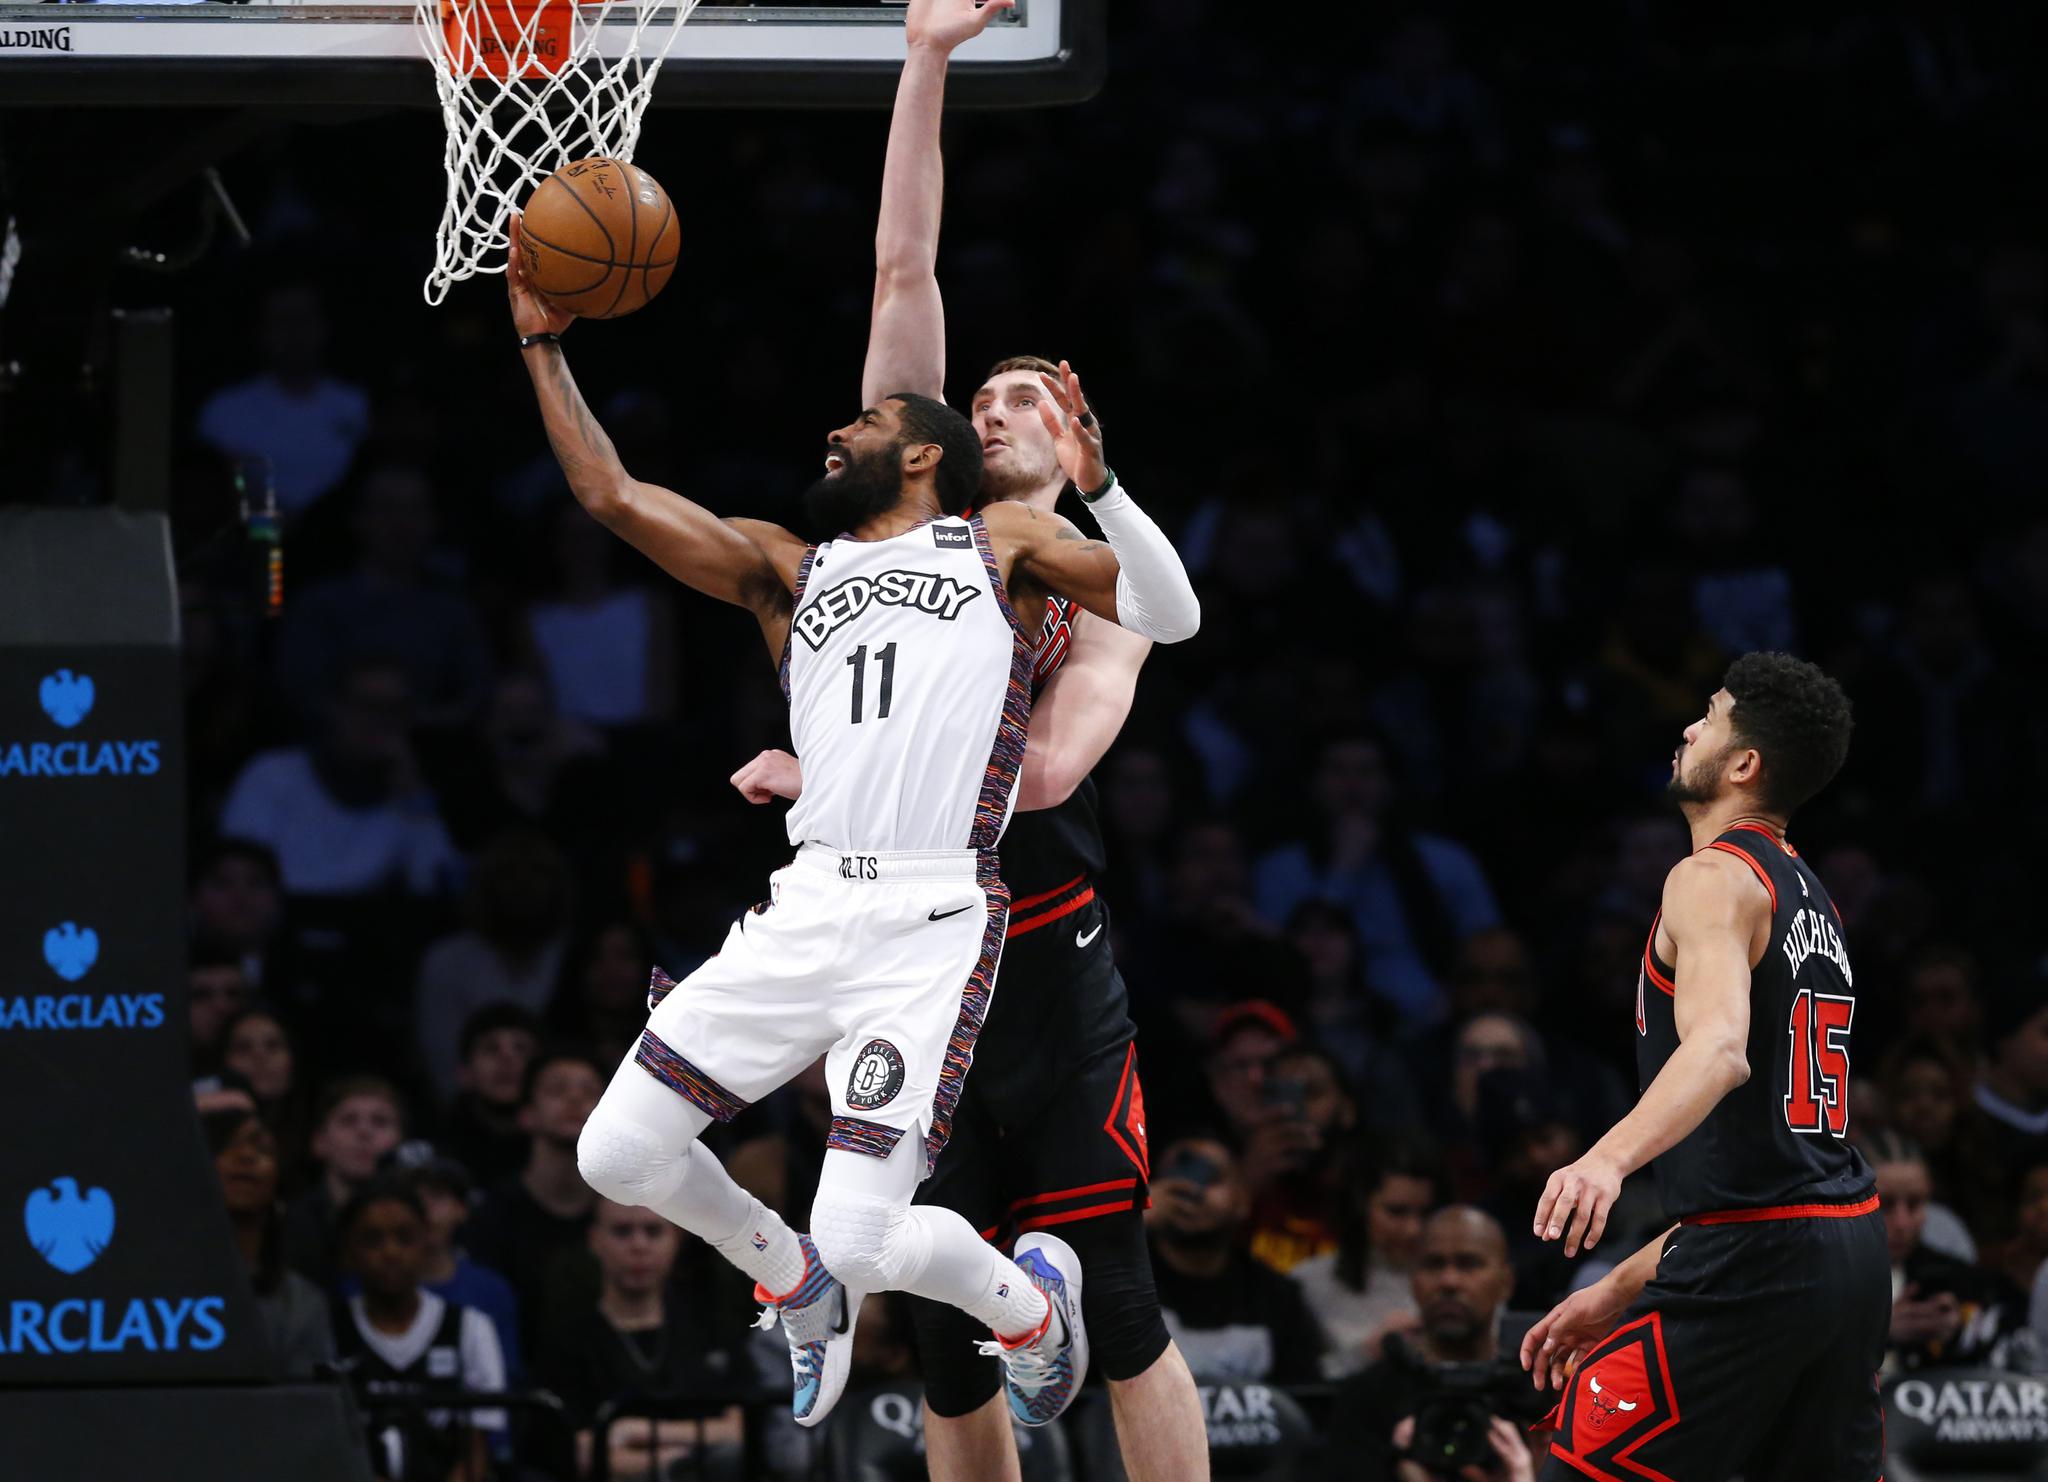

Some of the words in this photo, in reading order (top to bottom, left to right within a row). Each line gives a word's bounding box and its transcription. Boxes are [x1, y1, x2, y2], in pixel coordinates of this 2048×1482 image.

[0, 27, 70, 52] LDING
[935, 531, 969, 542] infor
[793, 569, 982, 653] BED-STUY
[846, 642, 897, 725] 11
[0, 740, 160, 778] ARCLAYS
[1784, 988, 1856, 1139] 15
[0, 1296, 226, 1355] RCLAYS
[1198, 1385, 1276, 1422] TAR
[1893, 1379, 2048, 1425] QATAR
